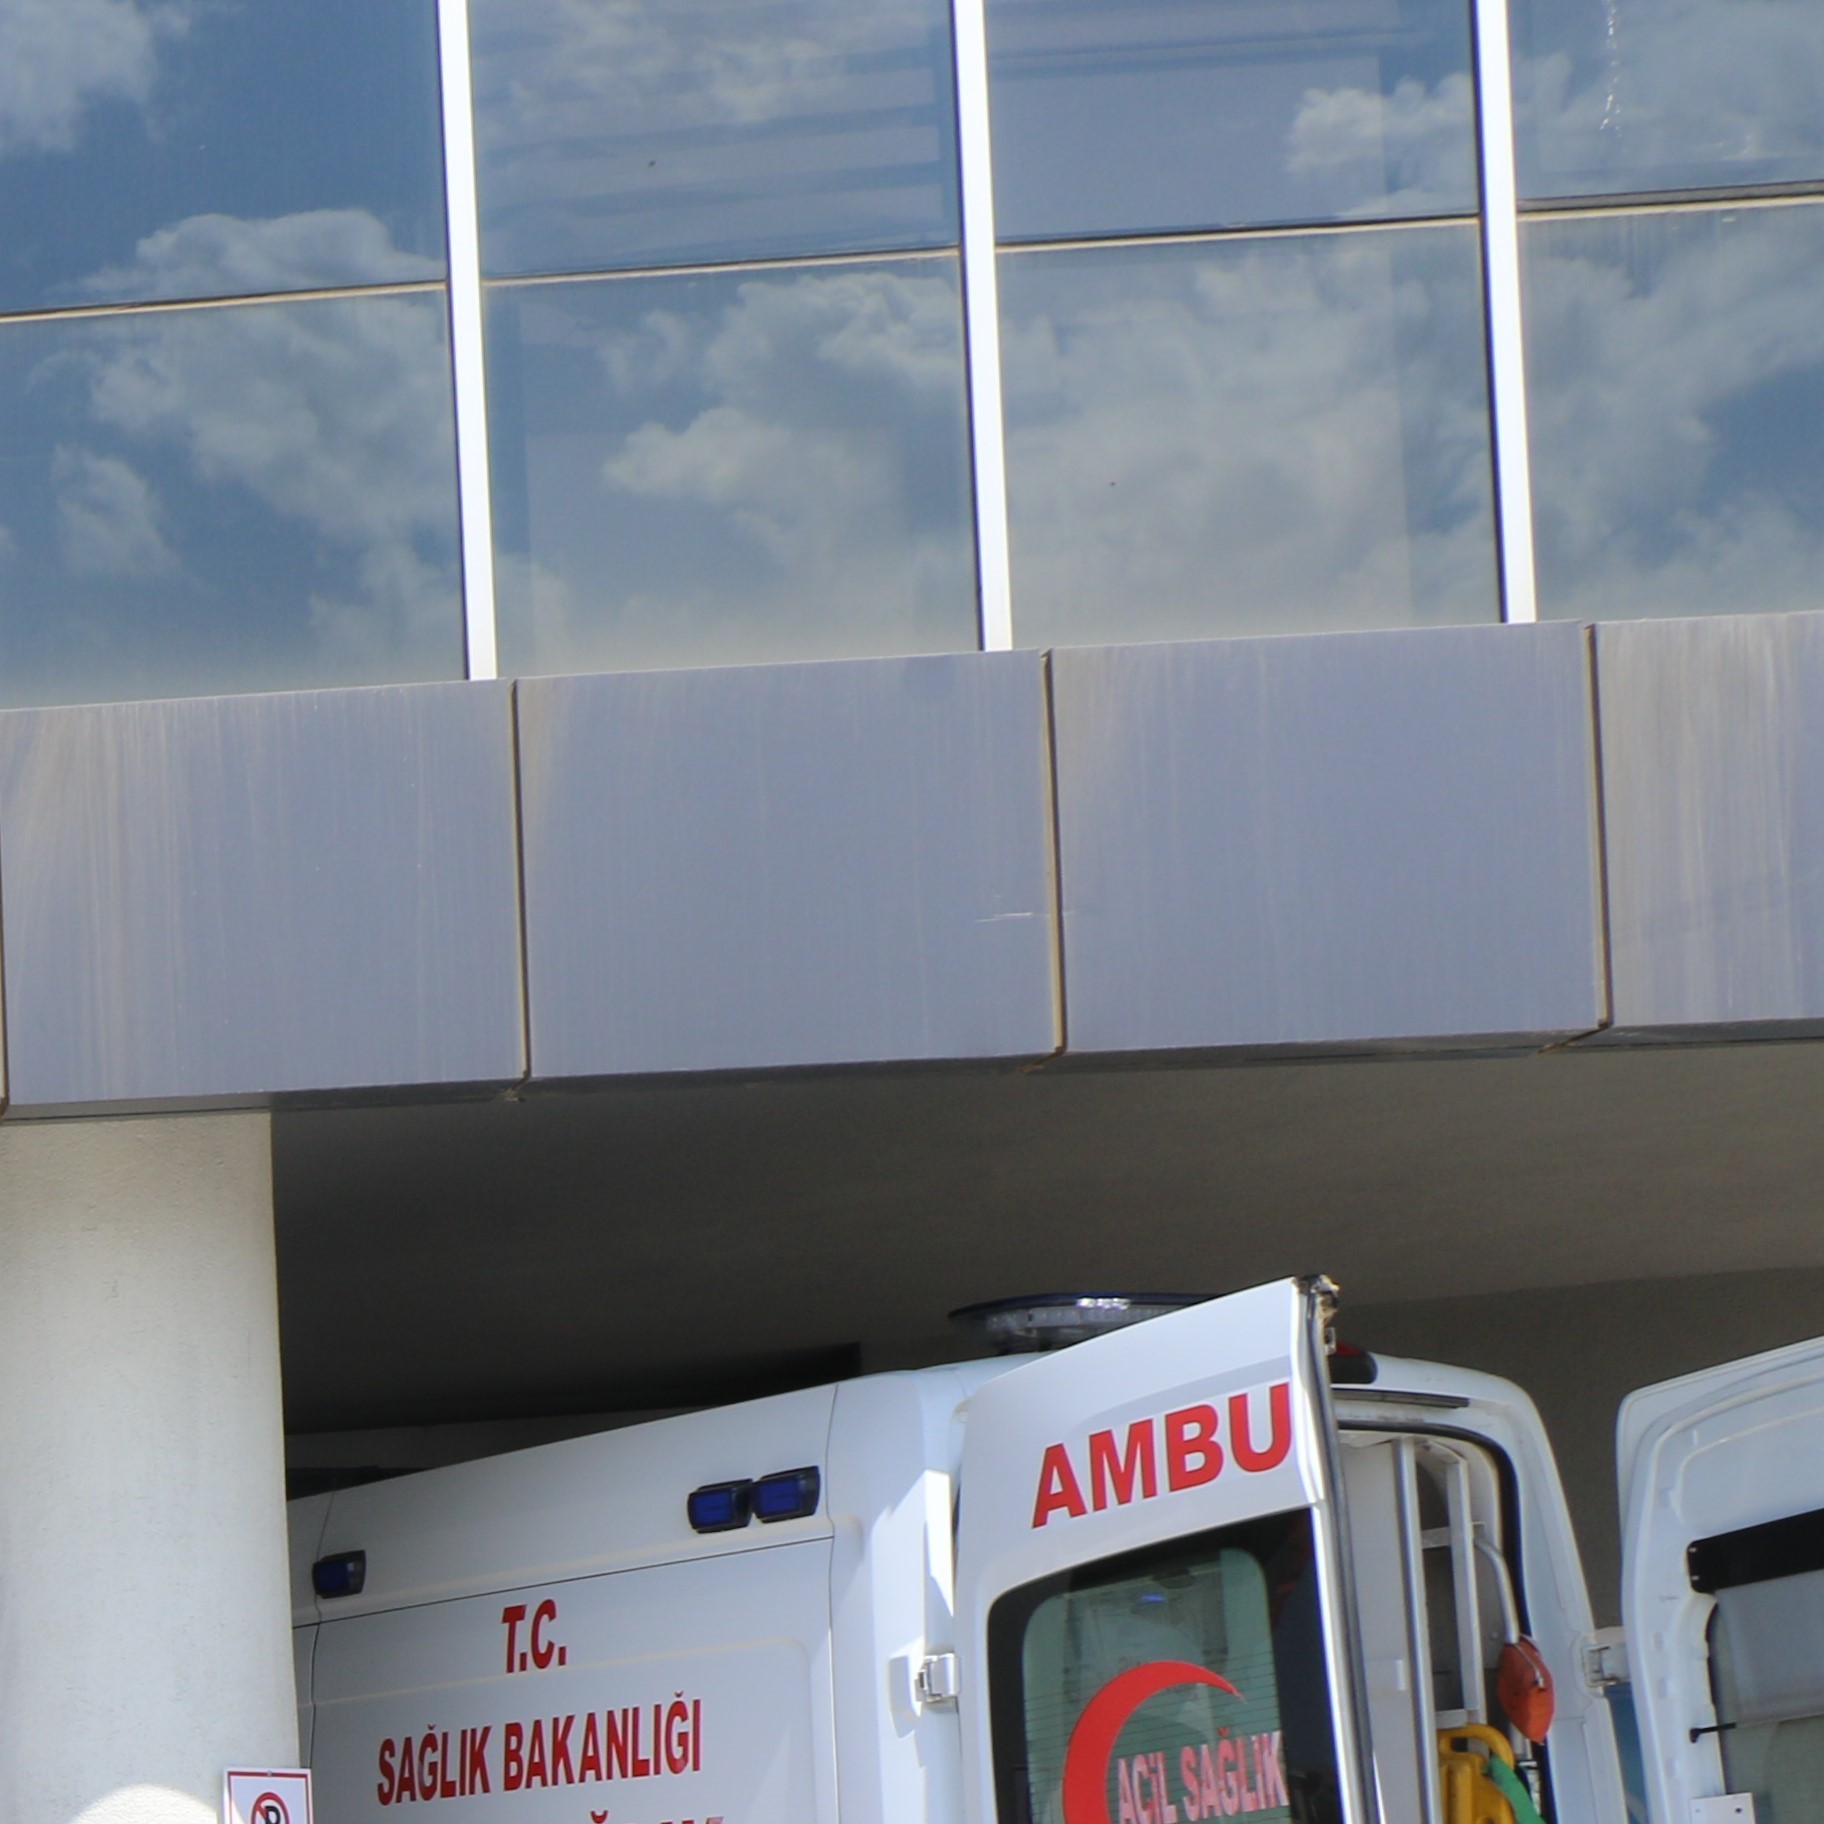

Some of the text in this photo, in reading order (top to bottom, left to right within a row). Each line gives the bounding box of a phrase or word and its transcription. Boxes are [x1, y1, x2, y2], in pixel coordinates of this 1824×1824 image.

[1032, 1382, 1292, 1529] AMBU
[501, 1599, 567, 1674] T.C.
[377, 1691, 702, 1806] SAĞLIK BAKANLIĞI
[1180, 1727, 1290, 1822] SAĞLIK
